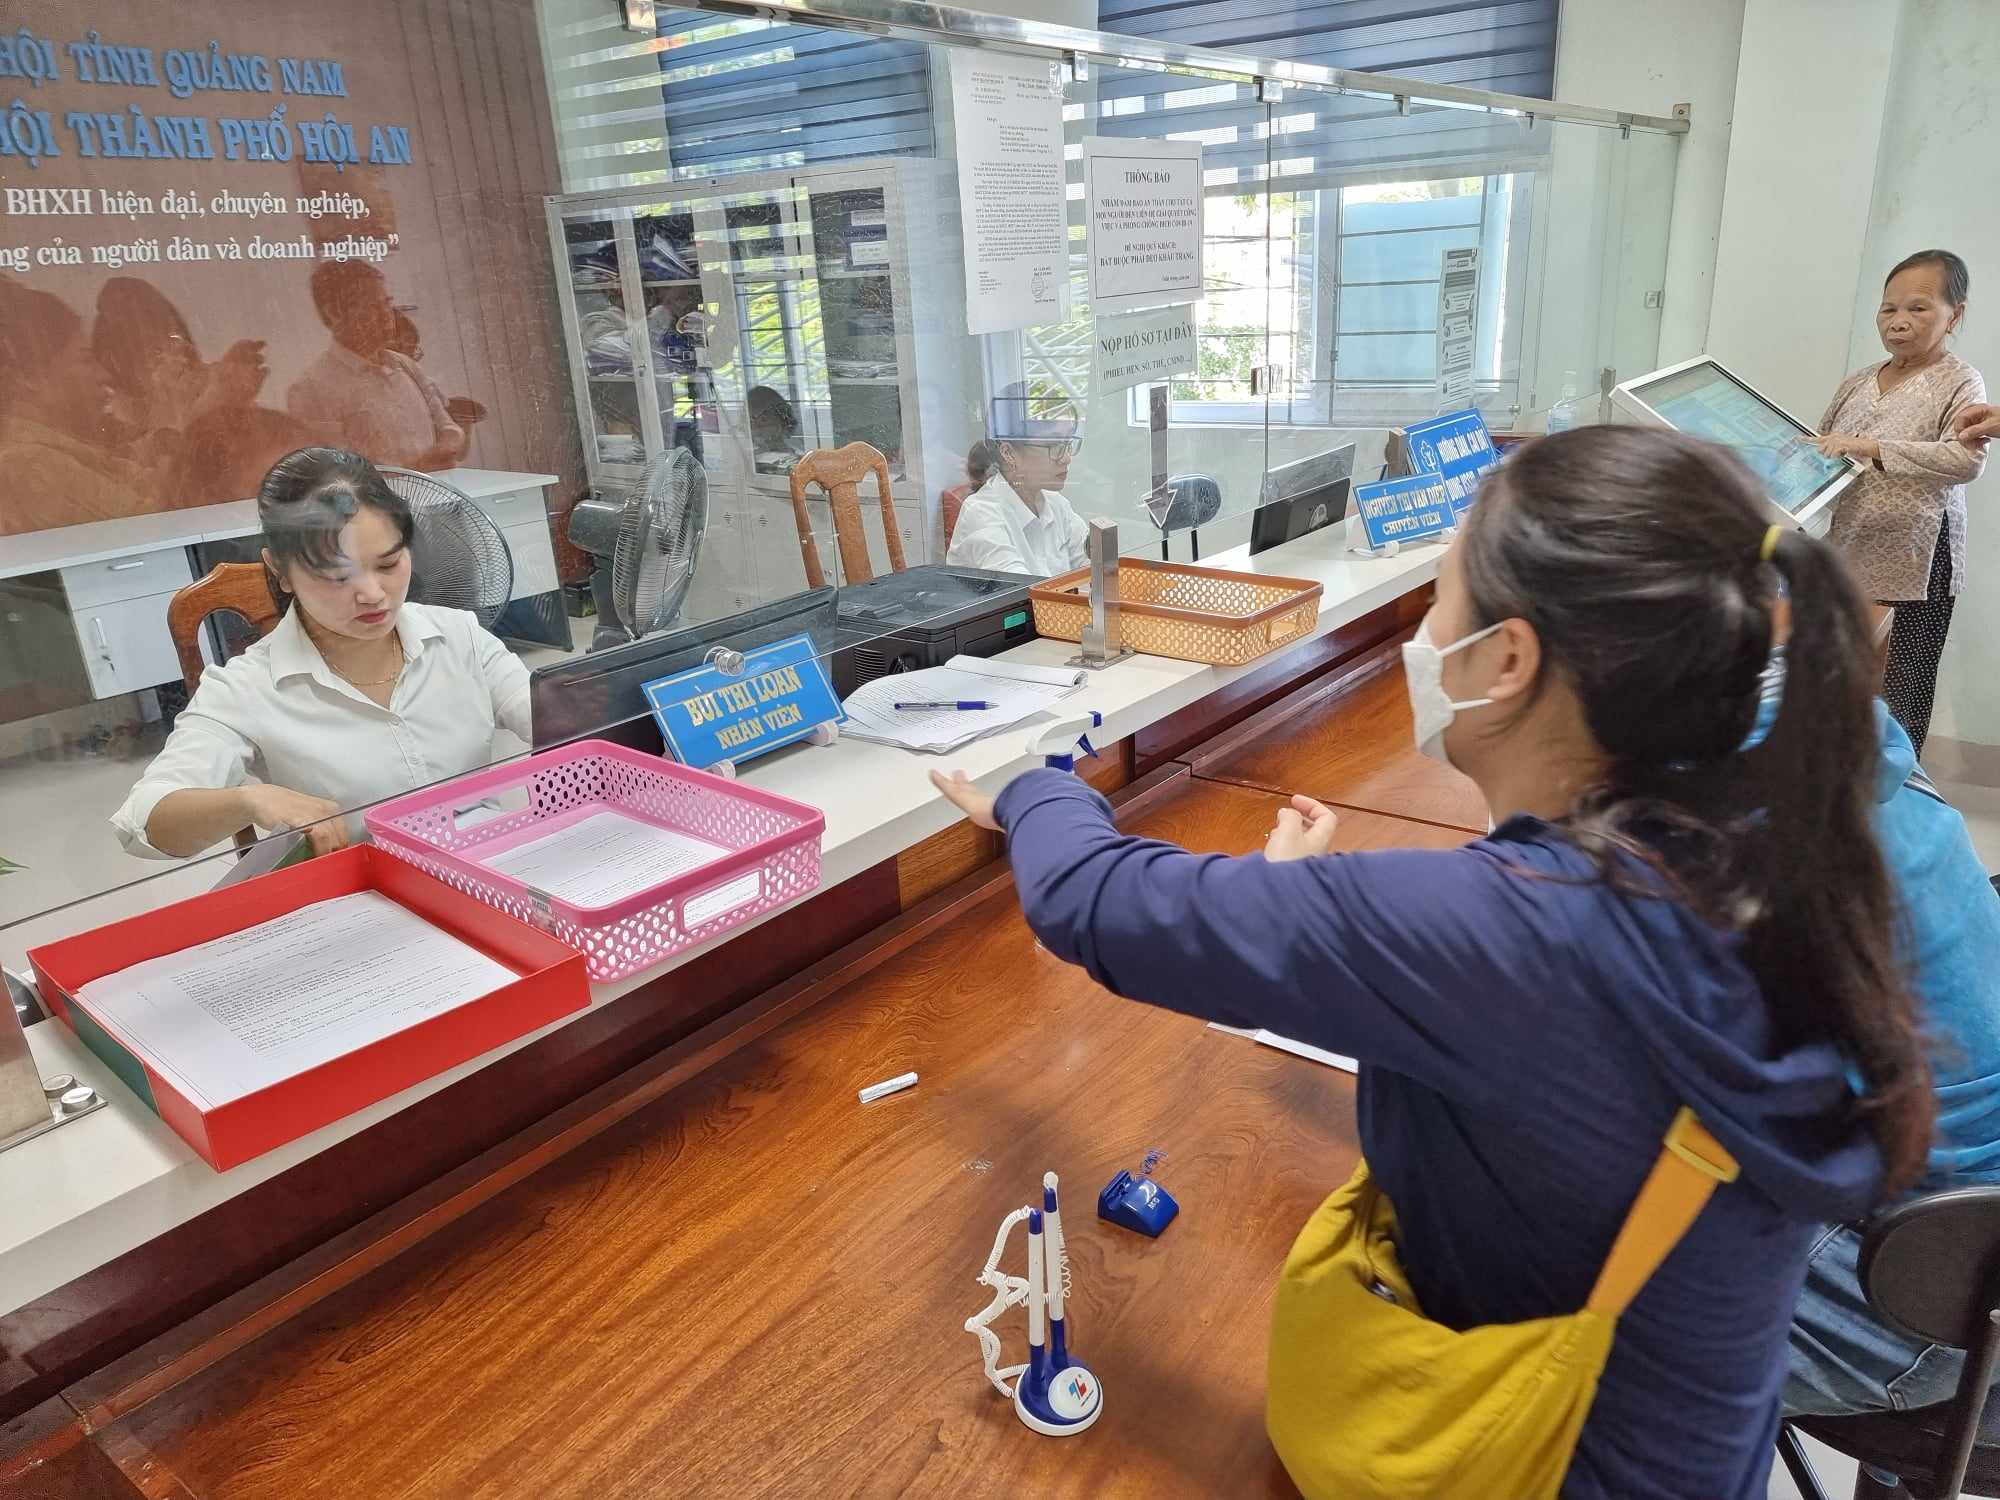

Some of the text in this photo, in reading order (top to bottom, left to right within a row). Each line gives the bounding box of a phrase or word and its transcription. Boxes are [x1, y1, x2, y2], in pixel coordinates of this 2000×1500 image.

[67, 31, 160, 87] TỈNH
[164, 40, 273, 98] QUẢNG
[278, 57, 348, 97] NAM
[66, 103, 217, 160] THÀNH
[218, 102, 293, 162] PHỐ
[297, 112, 361, 173] HỘI
[368, 126, 412, 164] AN
[1125, 168, 1170, 184] THÔNG BÁO
[5, 188, 370, 221] BHXH hiện đại, chuyên nghiệp,
[36, 236, 84, 265] của
[91, 237, 161, 269] người
[166, 236, 211, 262] dân
[215, 237, 242, 260] và
[248, 235, 315, 260] doanh
[1101, 337, 1122, 356] NỘP
[1141, 329, 1154, 346] SƠ
[1155, 326, 1172, 345] TẠI
[1174, 321, 1194, 341] ĐÂY
[1420, 510, 1441, 528] VIÊN
[682, 666, 803, 727] BÙI THỊ LOAN
[714, 703, 803, 750] NHÂN VIÊN
